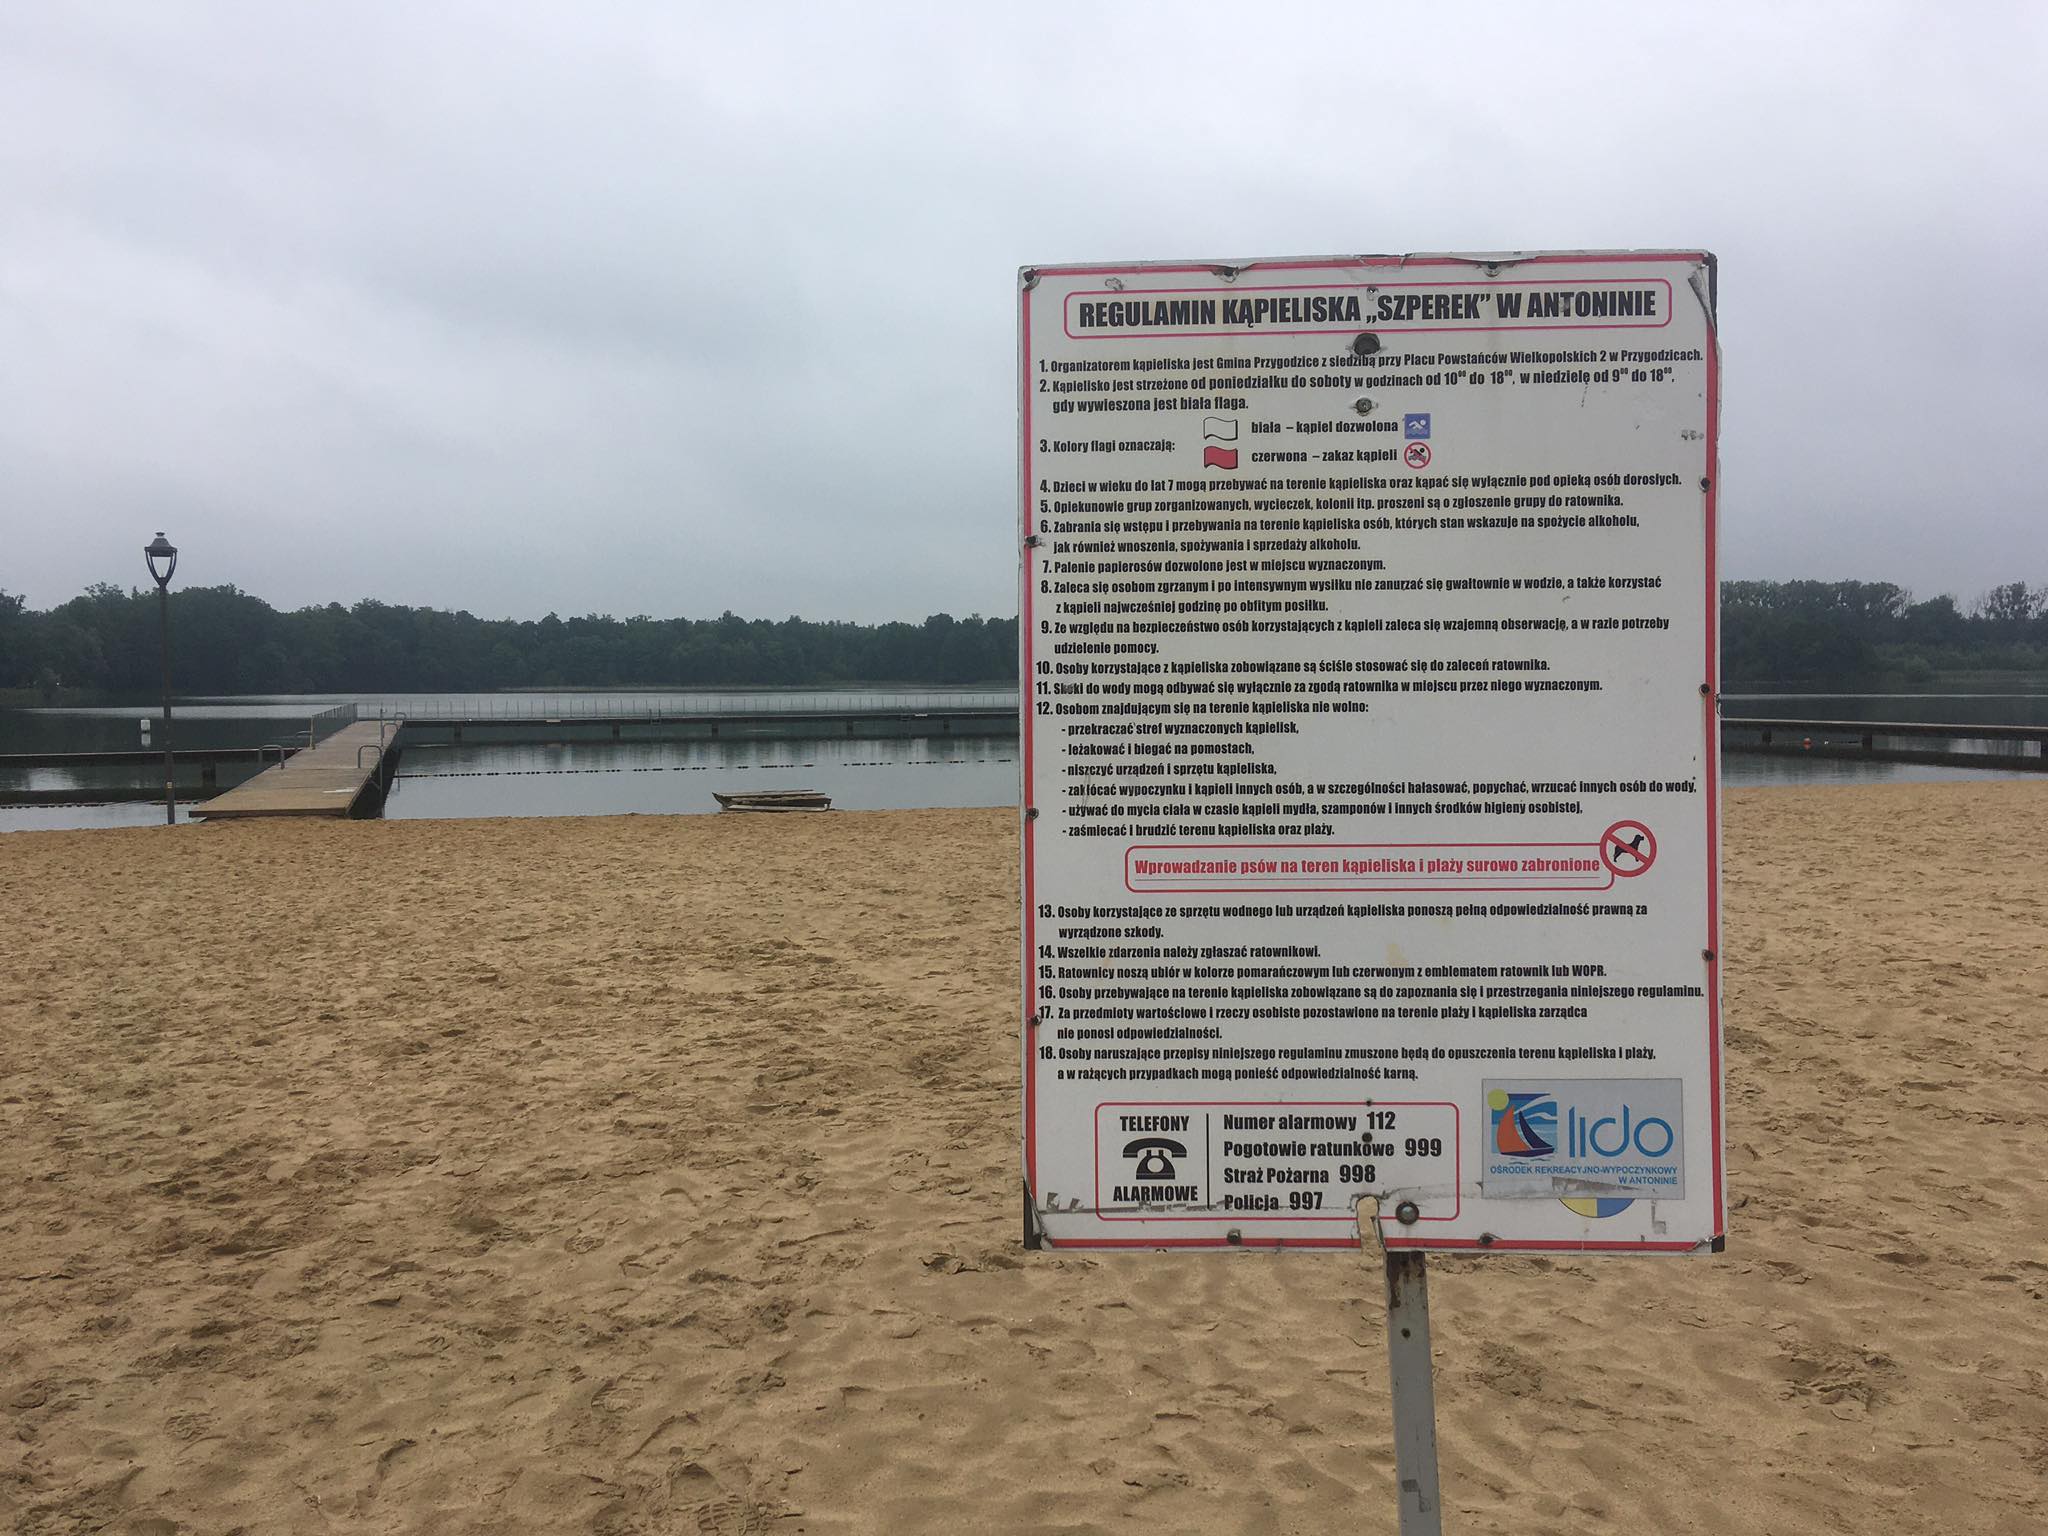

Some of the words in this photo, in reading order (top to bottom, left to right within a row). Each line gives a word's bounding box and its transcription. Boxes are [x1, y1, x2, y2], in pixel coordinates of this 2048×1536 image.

[1079, 299, 1215, 328] REGULAMIN
[1222, 295, 1361, 329] KĄPIELISKA
[1365, 292, 1491, 324] „SZPEREK”
[1495, 292, 1522, 318] W
[1526, 289, 1656, 319] ANTONINIE
[1038, 358, 1048, 372] 1.
[1050, 358, 1130, 374] Organizatorem
[1132, 357, 1190, 372] kąpieliska
[1191, 356, 1214, 370] jest
[1216, 356, 1251, 369] Gmina
[1253, 354, 1319, 370] Przygodzice
[1321, 356, 1327, 367] z
[1378, 355, 1401, 367] przy
[1403, 352, 1435, 366] Placu
[1437, 350, 1507, 365] Powstańców
[1509, 349, 1597, 365] Wielkopolskich
[1599, 349, 1606, 362] 2
[1608, 351, 1618, 362] w
[1621, 349, 1703, 362] Przygodzicach.
[1052, 398, 1074, 414] gdy
[1076, 397, 1150, 413] wywieszona
[1152, 396, 1177, 412] jest
[1180, 396, 1211, 410] biała
[1213, 395, 1248, 411] flaga.
[1251, 420, 1281, 433] biała
[1295, 420, 1332, 435] kąpiel
[1335, 419, 1398, 432] dozwolona
[1039, 438, 1050, 453] 3.
[1053, 440, 1088, 453] Kolory
[1090, 439, 1116, 453] flagi
[1118, 438, 1175, 453] oznaczają:
[1251, 451, 1307, 462] czerwona
[1321, 449, 1354, 462] zakaz
[1356, 448, 1397, 463] kąpieli
[1039, 478, 1050, 493] 4.
[1052, 480, 1085, 493] Dzieci
[1087, 482, 1097, 492] w
[1098, 479, 1132, 492] wieku
[1134, 479, 1148, 492] do
[1150, 479, 1166, 491] lat
[1167, 478, 1173, 491] 7
[1175, 480, 1206, 493] mogą
[1208, 477, 1267, 491] przebywać
[1269, 479, 1283, 490] na
[1285, 477, 1326, 490] terenie
[1328, 476, 1386, 491] kąpieliska
[1388, 478, 1413, 488] oraz
[1415, 474, 1449, 490] kąpać
[1451, 475, 1469, 490] się
[1470, 474, 1527, 489] wyłącznie
[1529, 474, 1550, 488] pod
[1552, 473, 1591, 488] opieką
[1593, 472, 1620, 486] osób
[1622, 472, 1682, 487] dorosłych.
[1052, 540, 1070, 554] jak
[1072, 540, 1115, 553] również
[1116, 539, 1178, 552] wnoszenia,
[1179, 538, 1244, 552] spożywania
[1246, 538, 1250, 551] i
[1252, 537, 1307, 552] sprzedaży
[1309, 537, 1360, 550] alkoholu.
[1042, 559, 1052, 573] 7.
[1054, 560, 1095, 573] Palenie
[1097, 559, 1162, 574] papierosów
[1164, 559, 1223, 572] dozwolone
[1225, 559, 1247, 572] jest
[1249, 560, 1259, 571] w
[1260, 558, 1305, 572] miejscu
[1307, 559, 1386, 572] wyznaczonym.
[1055, 603, 1061, 613] z
[1063, 600, 1101, 615] kąpieli
[1103, 599, 1175, 614] najwcześniej
[1177, 599, 1221, 614] godzinę
[1223, 601, 1237, 613] po
[1239, 599, 1282, 613] obfitym
[1284, 598, 1328, 612] posiłku.
[1054, 641, 1111, 654] udzielenie
[1113, 642, 1159, 654] pomocy.
[1036, 661, 1053, 674] 10.
[1055, 661, 1089, 675] Osoby
[1090, 661, 1161, 676] korzystające
[1163, 663, 1169, 673] z
[1170, 660, 1228, 675] kąpieliska
[1230, 660, 1301, 674] zobowiązane
[1303, 661, 1316, 674] są
[1318, 659, 1353, 672] ściśle
[1354, 658, 1408, 672] stosować
[1410, 658, 1427, 673] się
[1429, 658, 1444, 671] do
[1445, 658, 1489, 671] zaleceń
[1491, 658, 1550, 671] ratownika.
[1036, 702, 1053, 715] 12.
[1055, 702, 1099, 715] Osobom
[1101, 701, 1171, 716] znajdującym
[1173, 701, 1190, 716] się
[1192, 703, 1207, 714] na
[1208, 701, 1249, 713] terenie
[1251, 700, 1309, 715] kąpieliska
[1311, 700, 1330, 712] nie
[1331, 700, 1368, 712] wolno:
[1134, 859, 1237, 875] Wprowadzanie
[1240, 858, 1277, 874] psów
[1280, 860, 1298, 873] na
[1300, 859, 1339, 873] teren
[1342, 858, 1415, 875] kąpieliska
[1418, 858, 1424, 872] i
[1427, 857, 1463, 874] plaży
[1466, 859, 1518, 872] surowo
[1521, 858, 1600, 872] zabronione
[1058, 925, 1121, 940] wyrządzone
[1123, 925, 1164, 939] szkody.
[1038, 945, 1055, 958] 14.
[1056, 945, 1106, 958] Wszelkie
[1108, 945, 1160, 958] zdarzenia
[1162, 945, 1198, 959] należy
[1200, 944, 1247, 959] zgłaszać
[1249, 944, 1320, 958] ratownikowi.
[1056, 1026, 1074, 1039] nie
[1076, 1026, 1114, 1040] ponosi
[1116, 1026, 1222, 1040] odpowiedzialności.
[1057, 1069, 1064, 1080] a
[1066, 1068, 1076, 1080] w
[1077, 1066, 1126, 1082] rażących
[1128, 1066, 1199, 1080] przypadkach
[1201, 1068, 1232, 1082] mogą
[1234, 1066, 1278, 1080] ponieść
[1280, 1066, 1381, 1080] odpowiedzialność
[1383, 1066, 1418, 1081] karną.
[1119, 1115, 1189, 1132] TELEFONY
[1223, 1113, 1275, 1130] Numer
[1278, 1113, 1357, 1132] alarmowy
[1366, 1111, 1396, 1130] 112
[1569, 1104, 1674, 1158] lido
[1223, 1139, 1306, 1159] Pogotowie
[1310, 1140, 1395, 1157] ratunkowe
[1404, 1137, 1442, 1157] 999
[1223, 1166, 1263, 1184] Straż
[1266, 1166, 1329, 1184] Pożarna
[1339, 1163, 1375, 1183] 998
[1490, 1164, 1532, 1174] OŚRODEK
[1534, 1165, 1677, 1174] REKREACYJNO-WYPOCZYNKOWY
[1618, 1176, 1627, 1184] W
[1628, 1176, 1677, 1184] ANTONINIE
[1113, 1186, 1198, 1202] ALARMOWE
[1224, 1194, 1280, 1211] Policja
[1289, 1191, 1323, 1210] 997
